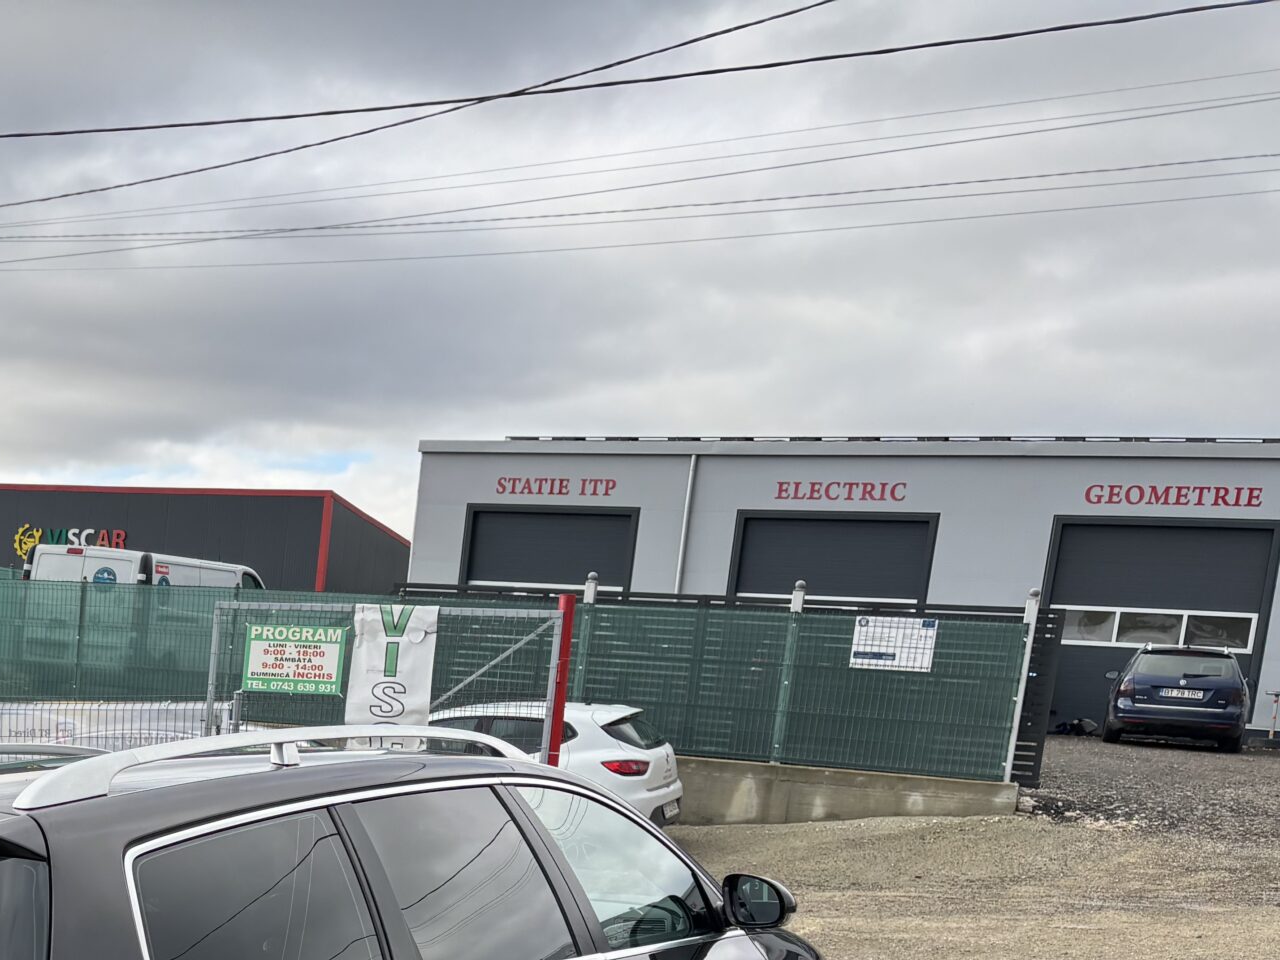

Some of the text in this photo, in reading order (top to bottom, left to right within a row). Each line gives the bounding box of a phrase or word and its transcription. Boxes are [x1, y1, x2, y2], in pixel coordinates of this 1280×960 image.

[496, 477, 617, 496] STATIE ITP
[774, 481, 907, 501] ELECTRIC
[1084, 484, 1263, 507] GEOMETRIE
[46, 528, 127, 551] VISCAR
[251, 626, 342, 642] PROGRAM
[263, 648, 286, 656] 9:00
[295, 650, 325, 658] 18:00
[247, 680, 336, 692] TEL: 0743 639 931
